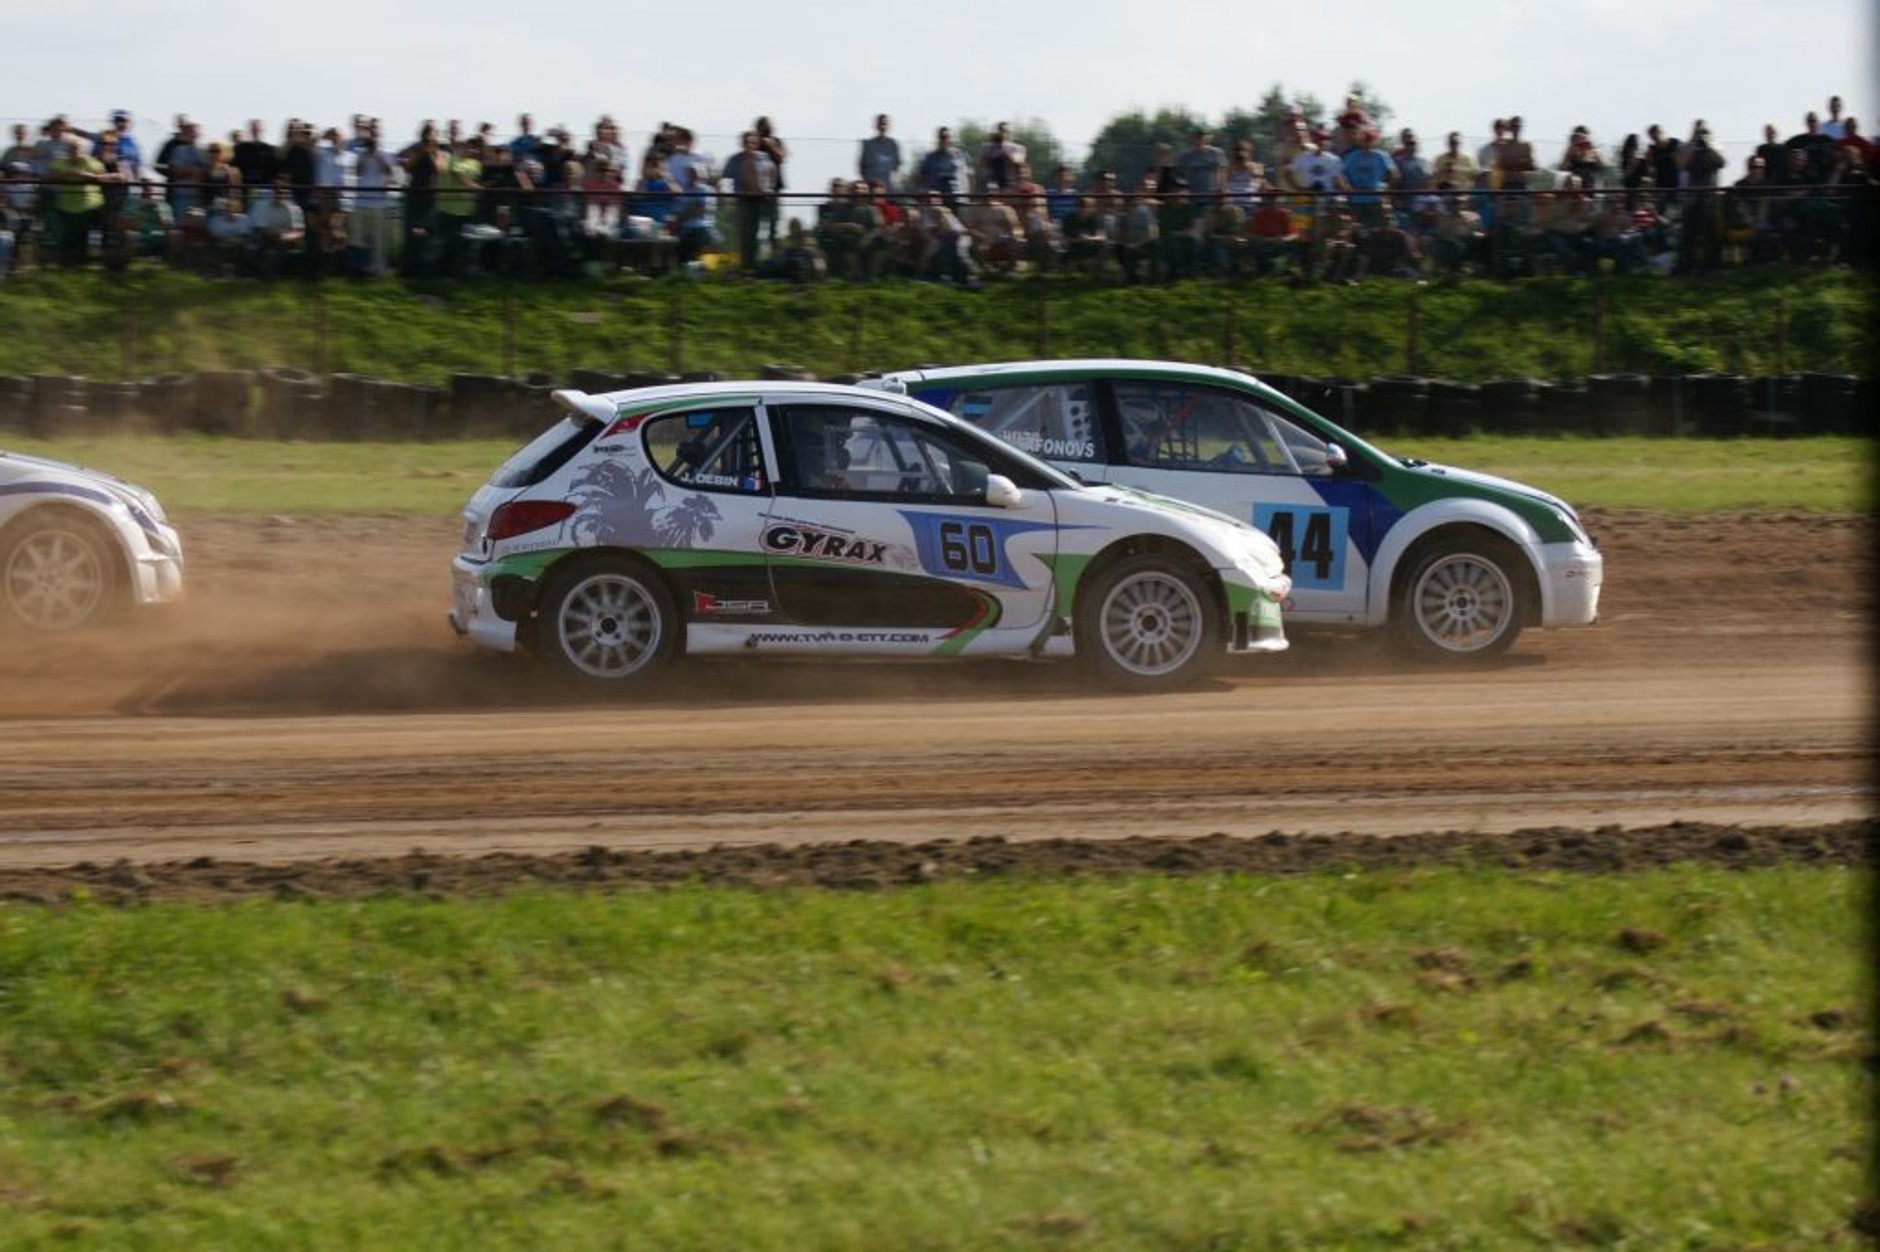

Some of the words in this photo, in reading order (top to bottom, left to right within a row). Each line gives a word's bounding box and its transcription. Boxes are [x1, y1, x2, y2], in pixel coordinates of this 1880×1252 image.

[766, 526, 887, 563] GYRAX
[941, 522, 997, 575] 60
[1268, 512, 1334, 579] 44
